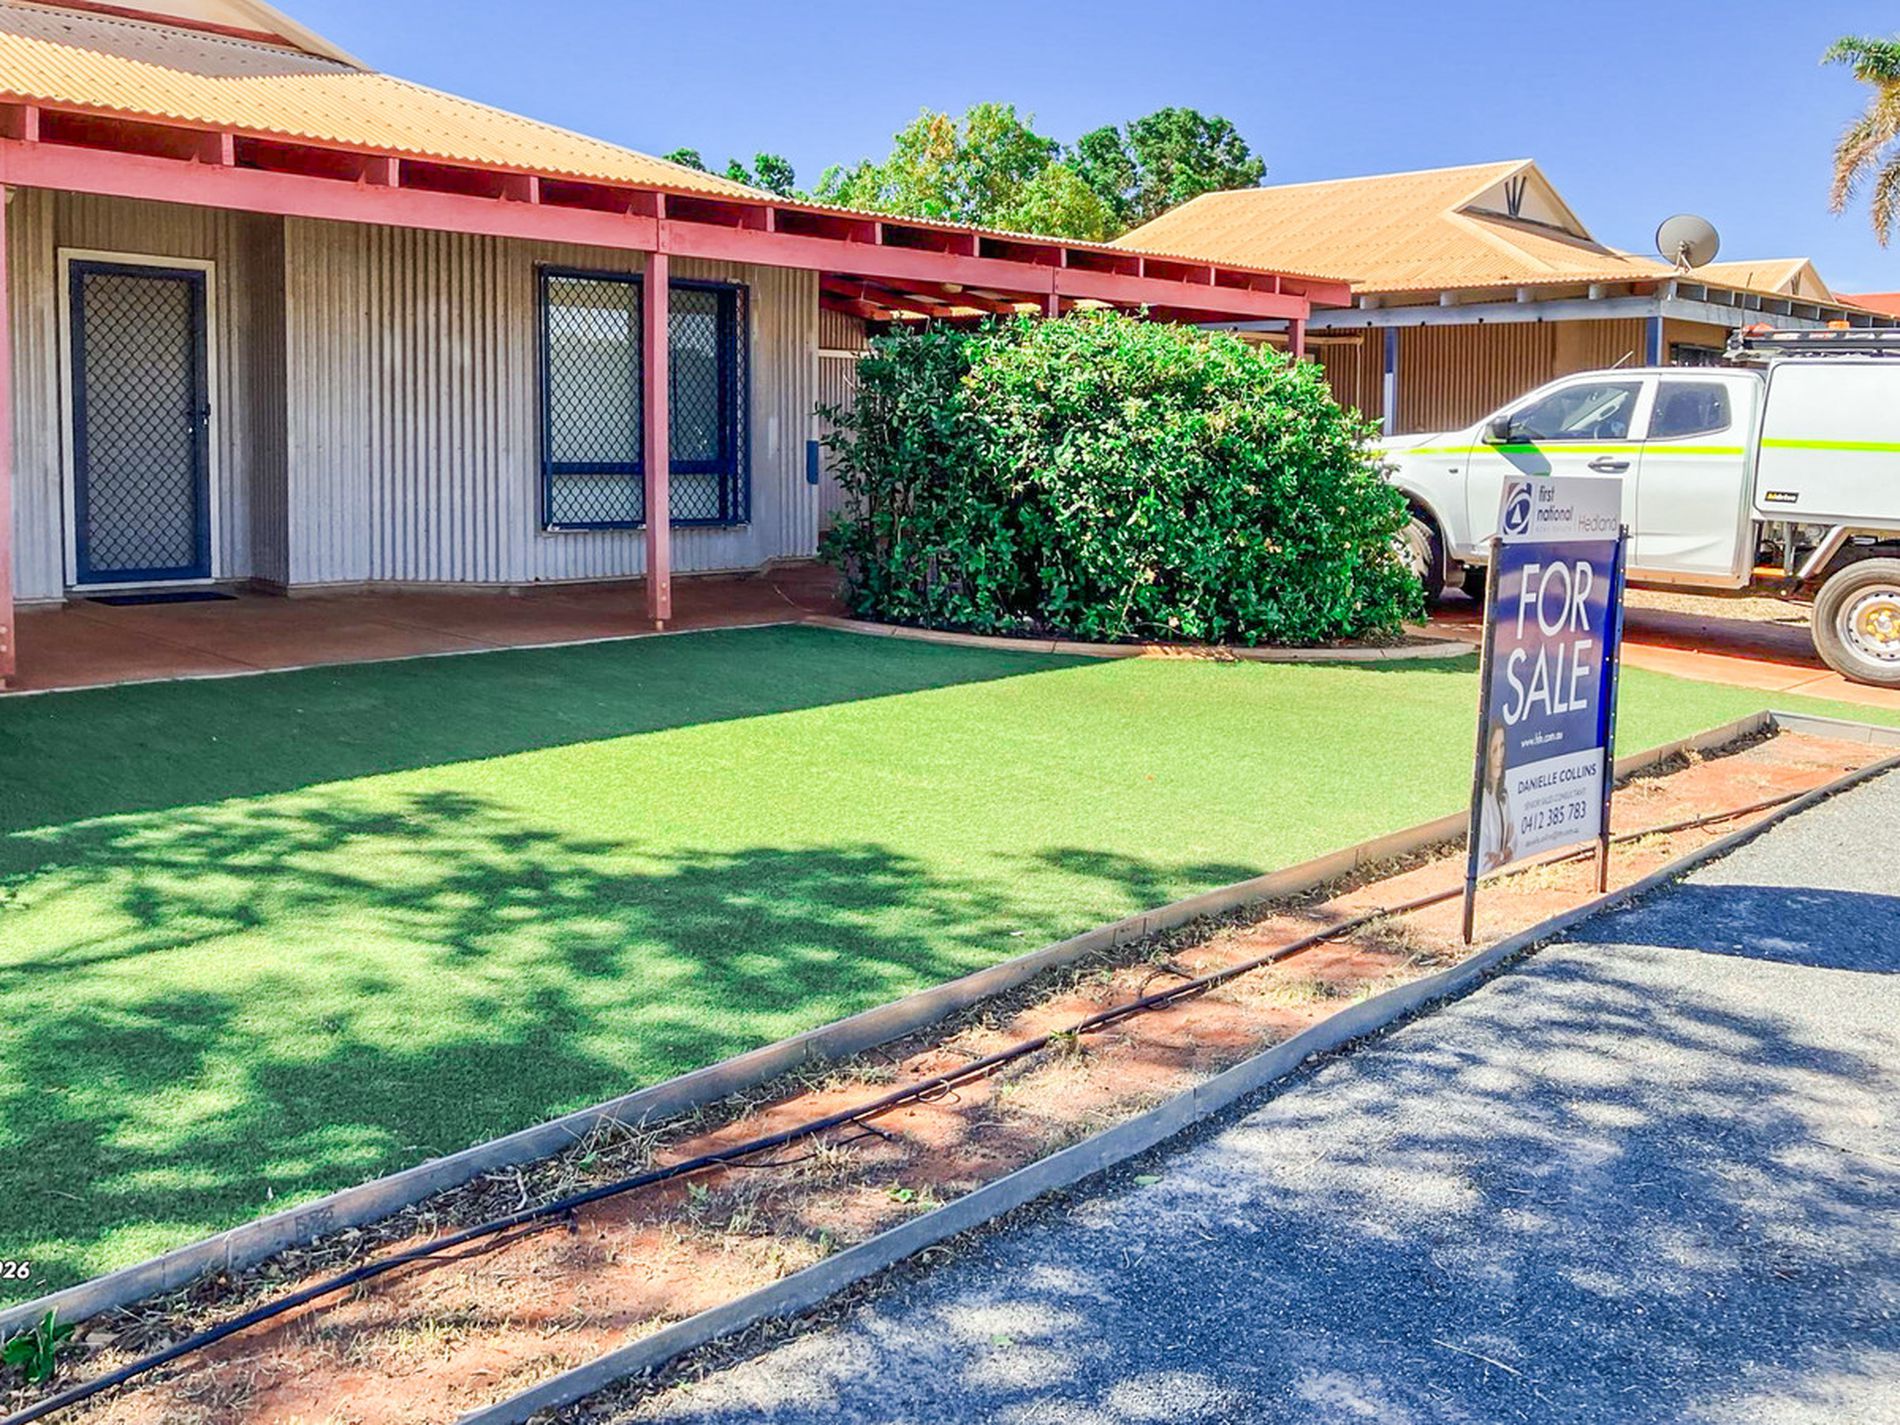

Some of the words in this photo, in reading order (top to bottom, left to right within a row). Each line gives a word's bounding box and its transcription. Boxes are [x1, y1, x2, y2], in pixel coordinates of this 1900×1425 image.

[1538, 485, 1555, 502] first
[1536, 505, 1574, 522] national
[1578, 514, 1618, 532] Hedland
[1516, 560, 1594, 640] FOR
[1502, 639, 1593, 726] SALE
[1517, 770, 1558, 794] DANIELLE
[1558, 763, 1597, 783] COLLINS
[1521, 811, 1545, 834] 0412
[1547, 805, 1565, 827] 385
[1568, 800, 1586, 820] 783
